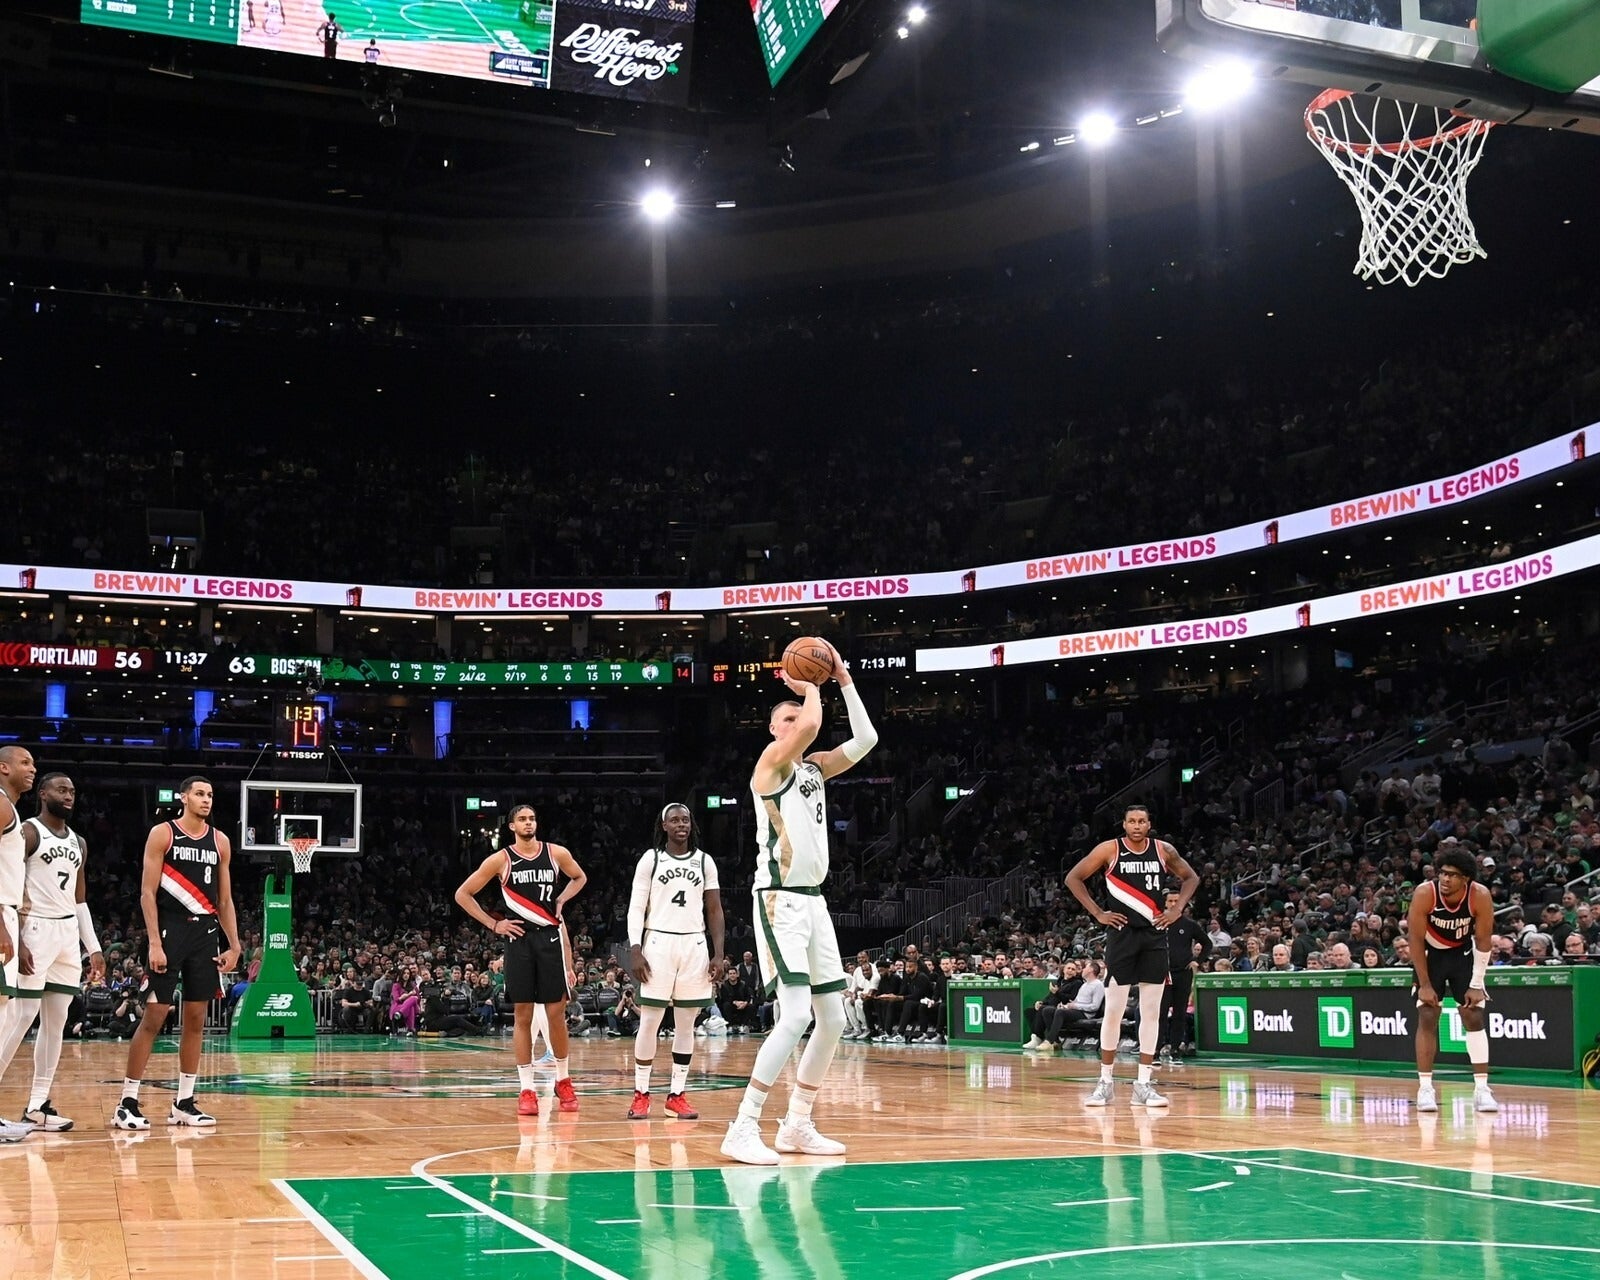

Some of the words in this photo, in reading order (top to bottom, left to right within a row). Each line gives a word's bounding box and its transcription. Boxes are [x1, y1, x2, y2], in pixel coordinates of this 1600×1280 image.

[667, 0, 687, 12] 3rd
[560, 23, 683, 63] Different
[580, 53, 667, 86] Here
[1331, 488, 1420, 526] BREWIN'
[1428, 458, 1520, 504] LEGENDS
[1026, 552, 1112, 580] BREWIN'
[1118, 537, 1216, 567] LEGENDS
[94, 573, 186, 593] BREWIN'
[193, 579, 293, 600] LEGENDS
[723, 585, 807, 606] BREWIN'
[813, 577, 909, 600] LEGENDS
[1360, 579, 1450, 612] BREWIN'
[1458, 555, 1553, 595] LEGENDS
[415, 591, 501, 609] BREWIN'
[507, 591, 604, 609] LEGENDS
[1059, 630, 1144, 655] BREWIN'
[1151, 618, 1248, 645] LEGENDS
[30, 647, 97, 666] PORTLAND
[115, 652, 142, 669] 56
[165, 651, 207, 666] 11:37
[229, 657, 256, 674] 63
[861, 659, 885, 669] 7:13
[887, 657, 906, 668] PM
[181, 665, 193, 673] 3rd
[392, 671, 399, 680] 0
[413, 672, 420, 681] 5
[434, 672, 446, 682] 57
[459, 672, 486, 682] 24/42
[504, 672, 527, 682] 9/19
[541, 672, 548, 681] 6
[564, 672, 571, 681] 6
[587, 672, 598, 681] 15
[611, 672, 622, 681] 19
[677, 667, 689, 677] 14
[713, 672, 725, 681] 63
[738, 663, 760, 673] 11:37
[285, 705, 321, 721] 11:37
[293, 721, 318, 746] 14
[816, 802, 823, 824] 8
[40, 846, 80, 869] BOSTON
[172, 845, 218, 865] PORTLAND
[204, 865, 212, 884] 8
[511, 869, 554, 884] PORTLAND
[658, 867, 701, 887] BOSTON
[1119, 861, 1160, 874] PORTLAND
[57, 871, 70, 890] 7
[1145, 874, 1160, 891] 34
[538, 883, 553, 902] 72
[671, 890, 687, 907] 4
[1430, 915, 1471, 930] PORTLAND
[269, 933, 288, 943] VISTA
[965, 1003, 982, 1026] TD
[986, 1006, 1011, 1023] Bank
[1220, 1005, 1245, 1034] TD
[1253, 1009, 1293, 1032] Bank
[1321, 1006, 1350, 1037] TD
[1360, 1010, 1408, 1035] Bank
[1489, 1012, 1546, 1039] Bank
